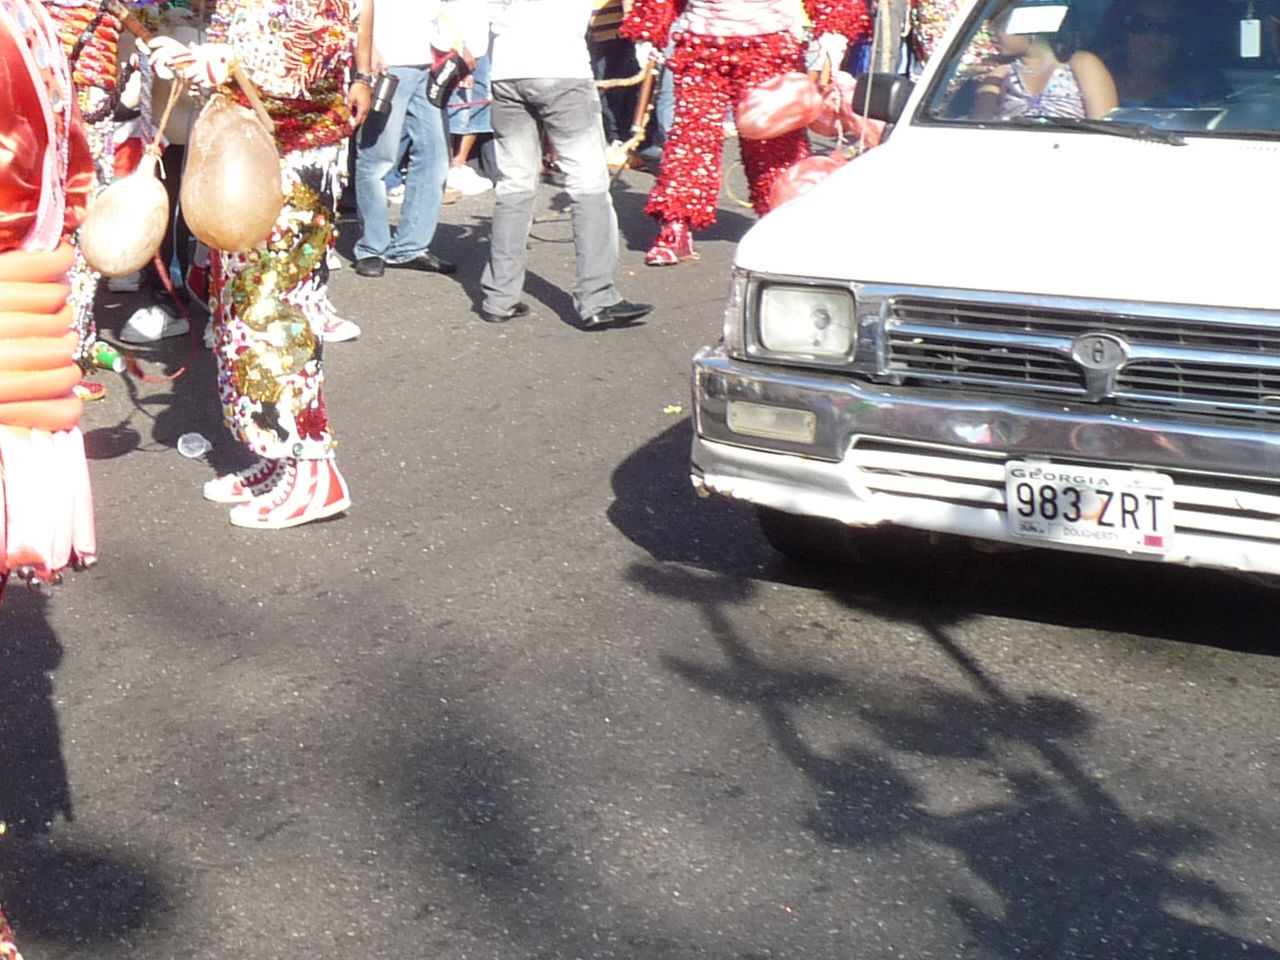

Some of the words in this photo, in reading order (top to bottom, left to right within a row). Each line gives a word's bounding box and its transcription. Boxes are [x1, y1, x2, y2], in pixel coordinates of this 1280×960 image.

[1010, 467, 1110, 486] GEORGIA
[1016, 482, 1082, 522] 983
[1095, 489, 1163, 532] ZRT
